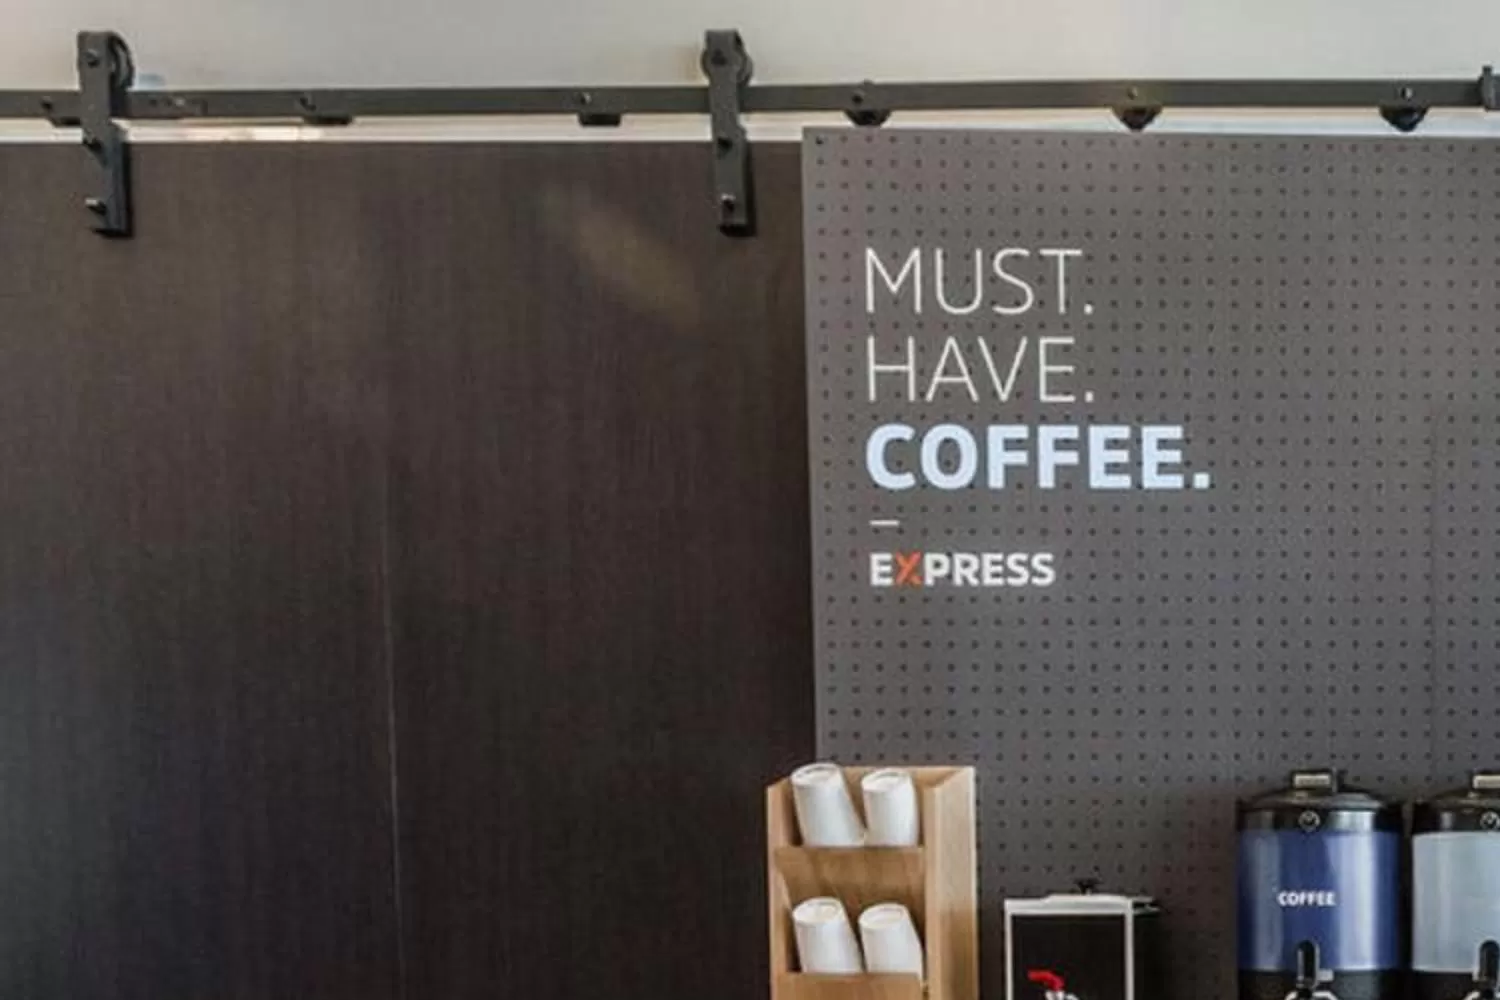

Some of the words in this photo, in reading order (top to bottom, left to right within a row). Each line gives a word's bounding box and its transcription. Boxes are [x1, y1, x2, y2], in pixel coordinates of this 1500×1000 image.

[865, 247, 1094, 314] MUST.
[867, 336, 1094, 402] HAVE.
[866, 423, 1210, 490] COFFEE.
[869, 551, 1056, 586] EXPRESS
[1279, 890, 1336, 907] COFFEE
